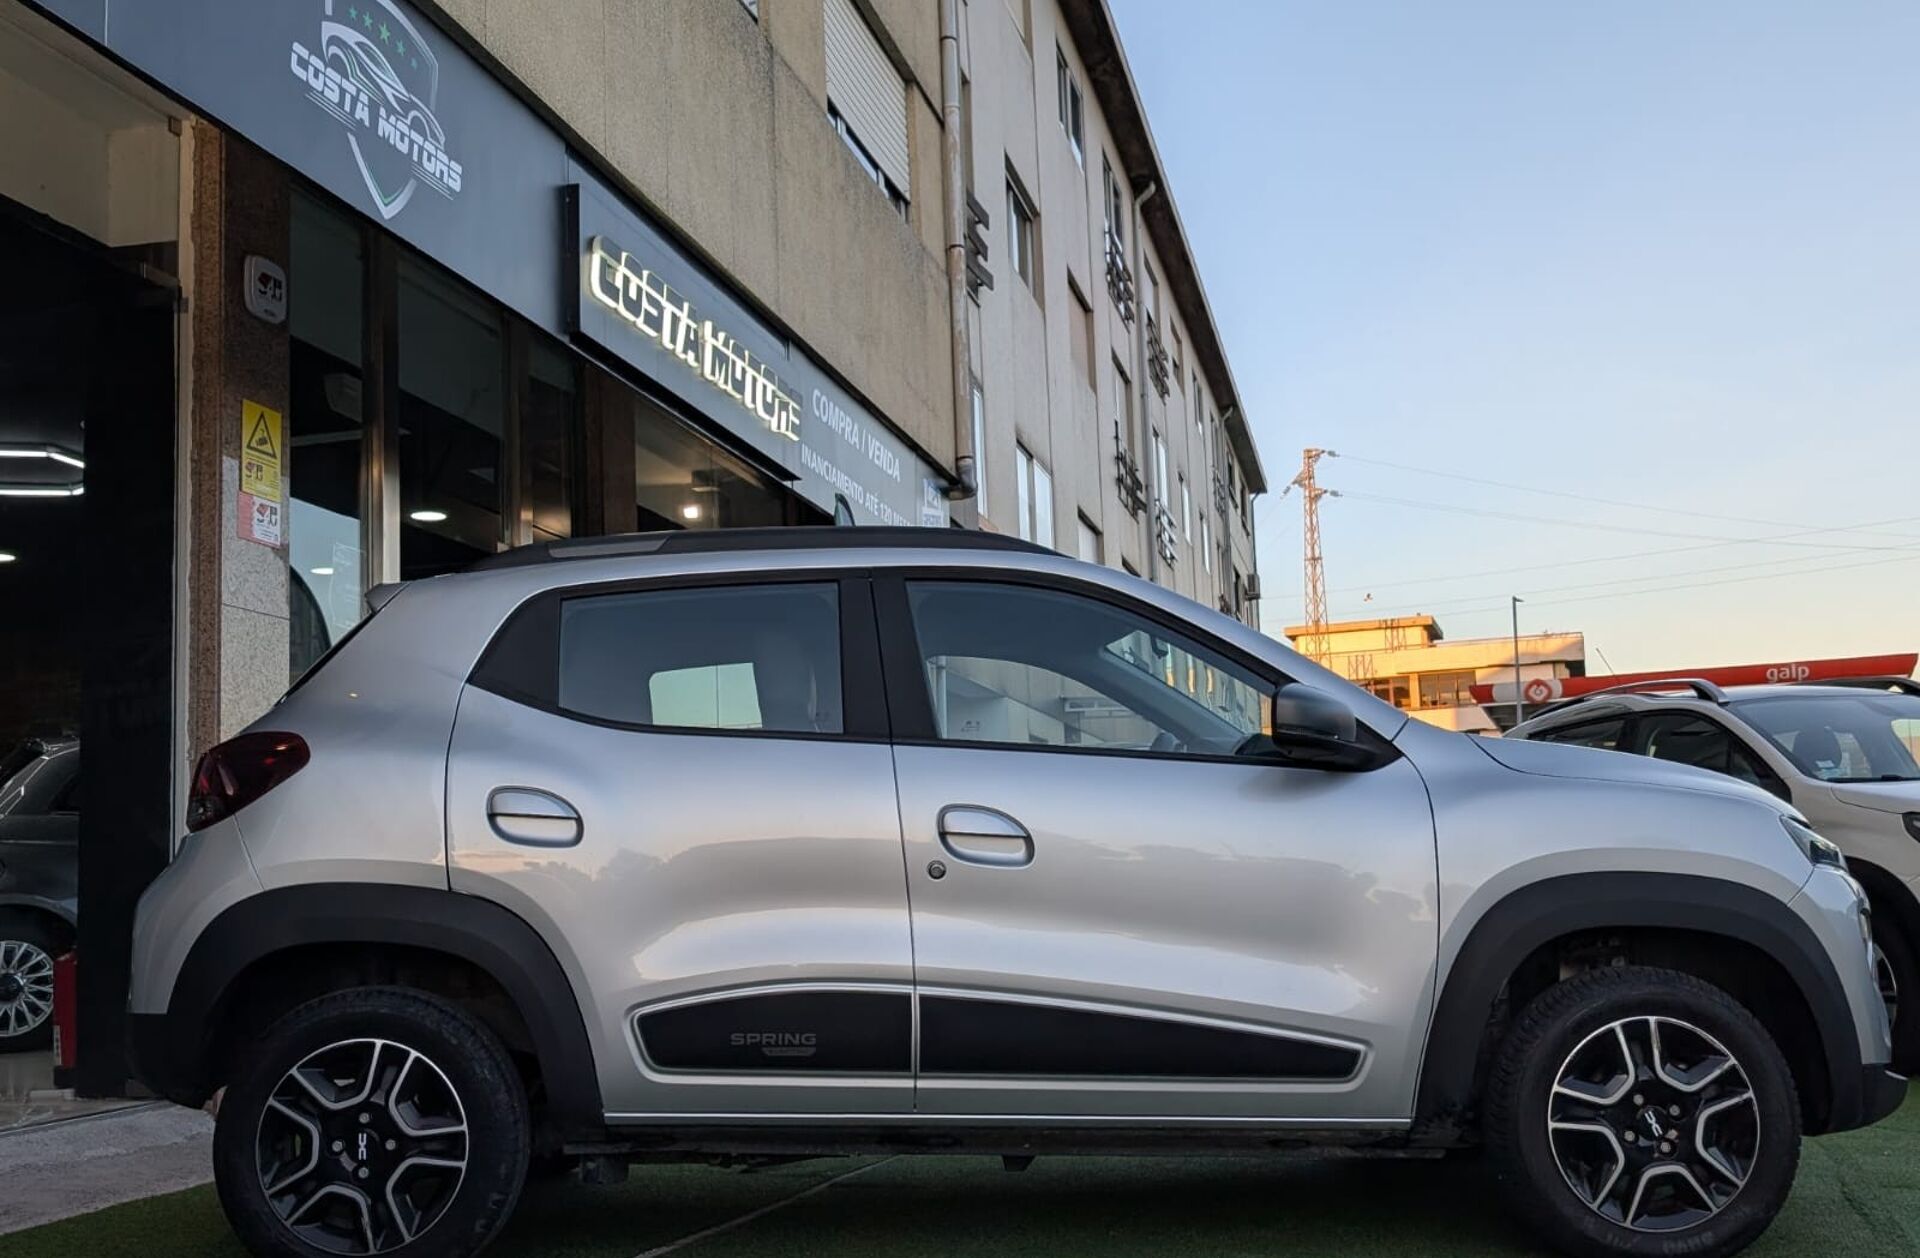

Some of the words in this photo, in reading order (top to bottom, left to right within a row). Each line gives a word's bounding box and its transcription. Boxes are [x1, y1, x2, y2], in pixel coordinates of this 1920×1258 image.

[291, 41, 370, 128] COSTA
[377, 105, 463, 193] MOTORS
[590, 235, 700, 367] COSTA
[812, 388, 860, 450] COMPRA
[867, 432, 901, 483] VENDA
[800, 442, 864, 505] INANCIAMENTO
[865, 491, 879, 517] ATÉ
[880, 502, 893, 527] 120
[1766, 663, 1810, 684] galp
[730, 1033, 817, 1046] SPRING
